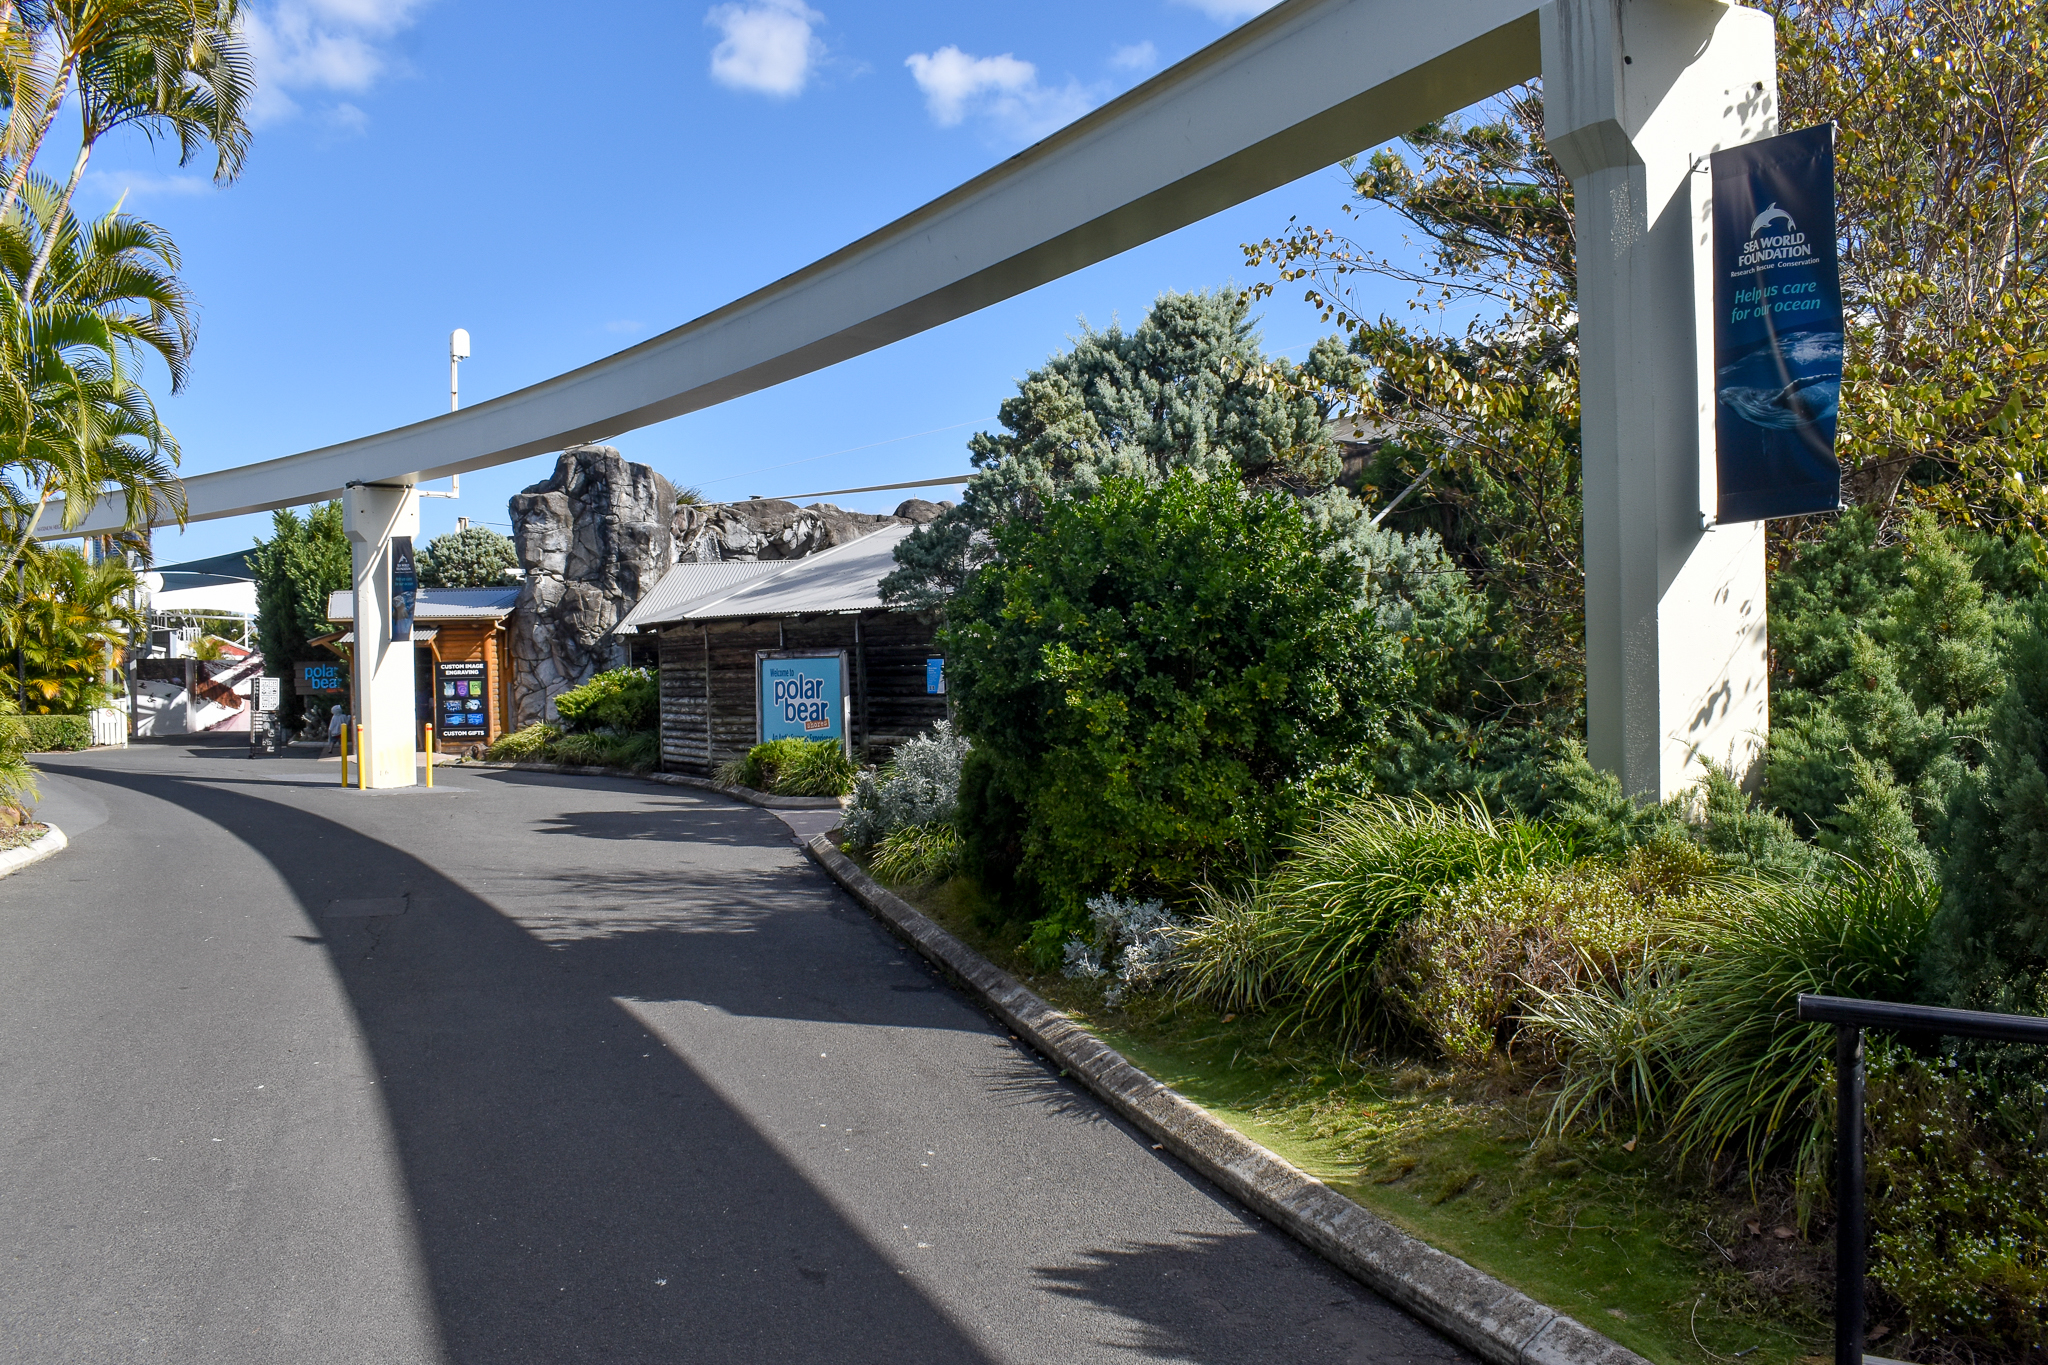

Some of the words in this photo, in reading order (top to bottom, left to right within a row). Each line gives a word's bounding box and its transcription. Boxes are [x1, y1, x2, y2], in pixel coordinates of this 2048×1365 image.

[1743, 240, 1760, 254] SEA
[1760, 232, 1806, 249] WORLD
[1738, 243, 1812, 267] FOUNDATION
[1730, 267, 1756, 278] Research
[1777, 257, 1820, 268] Conservation
[1734, 286, 1762, 304] Help
[1763, 285, 1779, 298] us
[1782, 281, 1817, 295] care
[1731, 307, 1751, 324] for
[1753, 303, 1772, 318] our
[1774, 298, 1821, 313] ocean
[769, 668, 789, 677] Welcome
[789, 668, 795, 677] to
[774, 673, 824, 706] polar
[784, 696, 829, 722] bear
